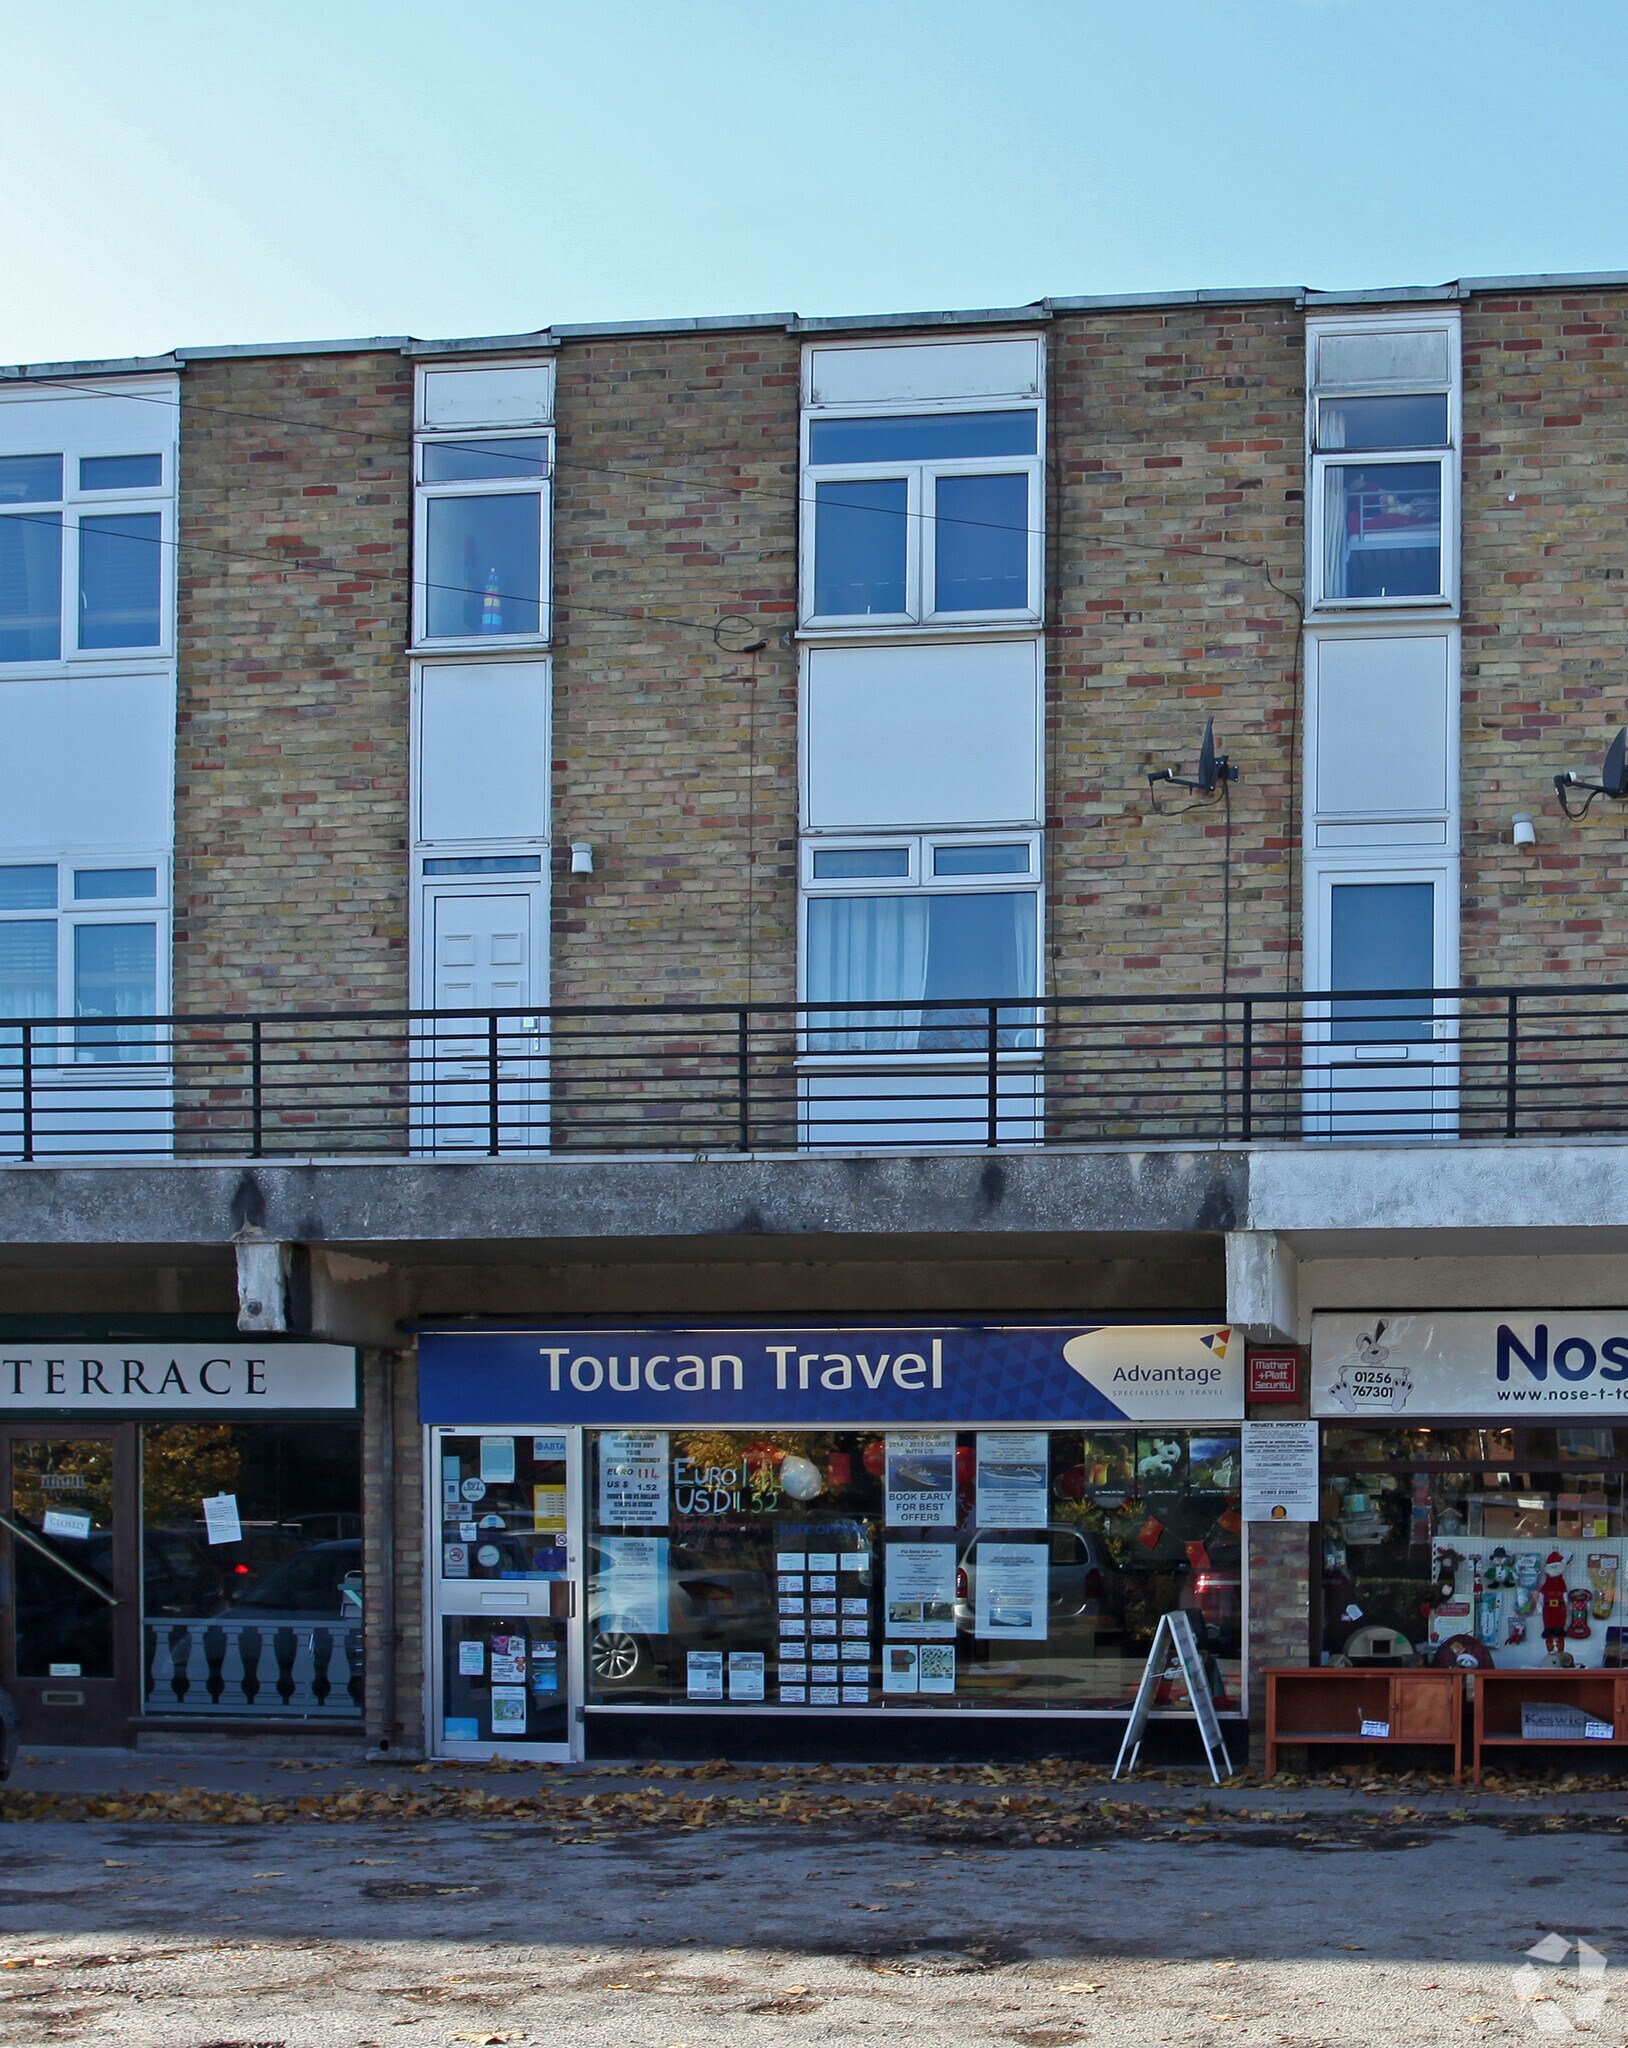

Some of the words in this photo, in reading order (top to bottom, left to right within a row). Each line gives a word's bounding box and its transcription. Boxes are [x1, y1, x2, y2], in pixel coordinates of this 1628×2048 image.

[540, 1348, 743, 1391] Toucan
[765, 1339, 942, 1390] Travel
[1255, 1361, 1290, 1370] Mather
[2, 1358, 267, 1395] TERRACE
[1112, 1364, 1222, 1385] Advantage
[1258, 1371, 1288, 1380] +Platt
[1354, 1371, 1392, 1384] 01256
[1254, 1381, 1291, 1390] Security
[1351, 1385, 1393, 1398] 767301
[544, 1441, 566, 1450] ABTA
[607, 1468, 633, 1476] EURO
[607, 1480, 620, 1488] US
[622, 1480, 629, 1488] $
[674, 1488, 732, 1514] USD
[888, 1492, 917, 1501] BOOK
[920, 1492, 952, 1501] EARLY
[896, 1503, 916, 1511] FOR
[918, 1503, 944, 1511] BEST
[901, 1513, 940, 1521] OFFERS
[49, 1516, 84, 1531] CLOSED
